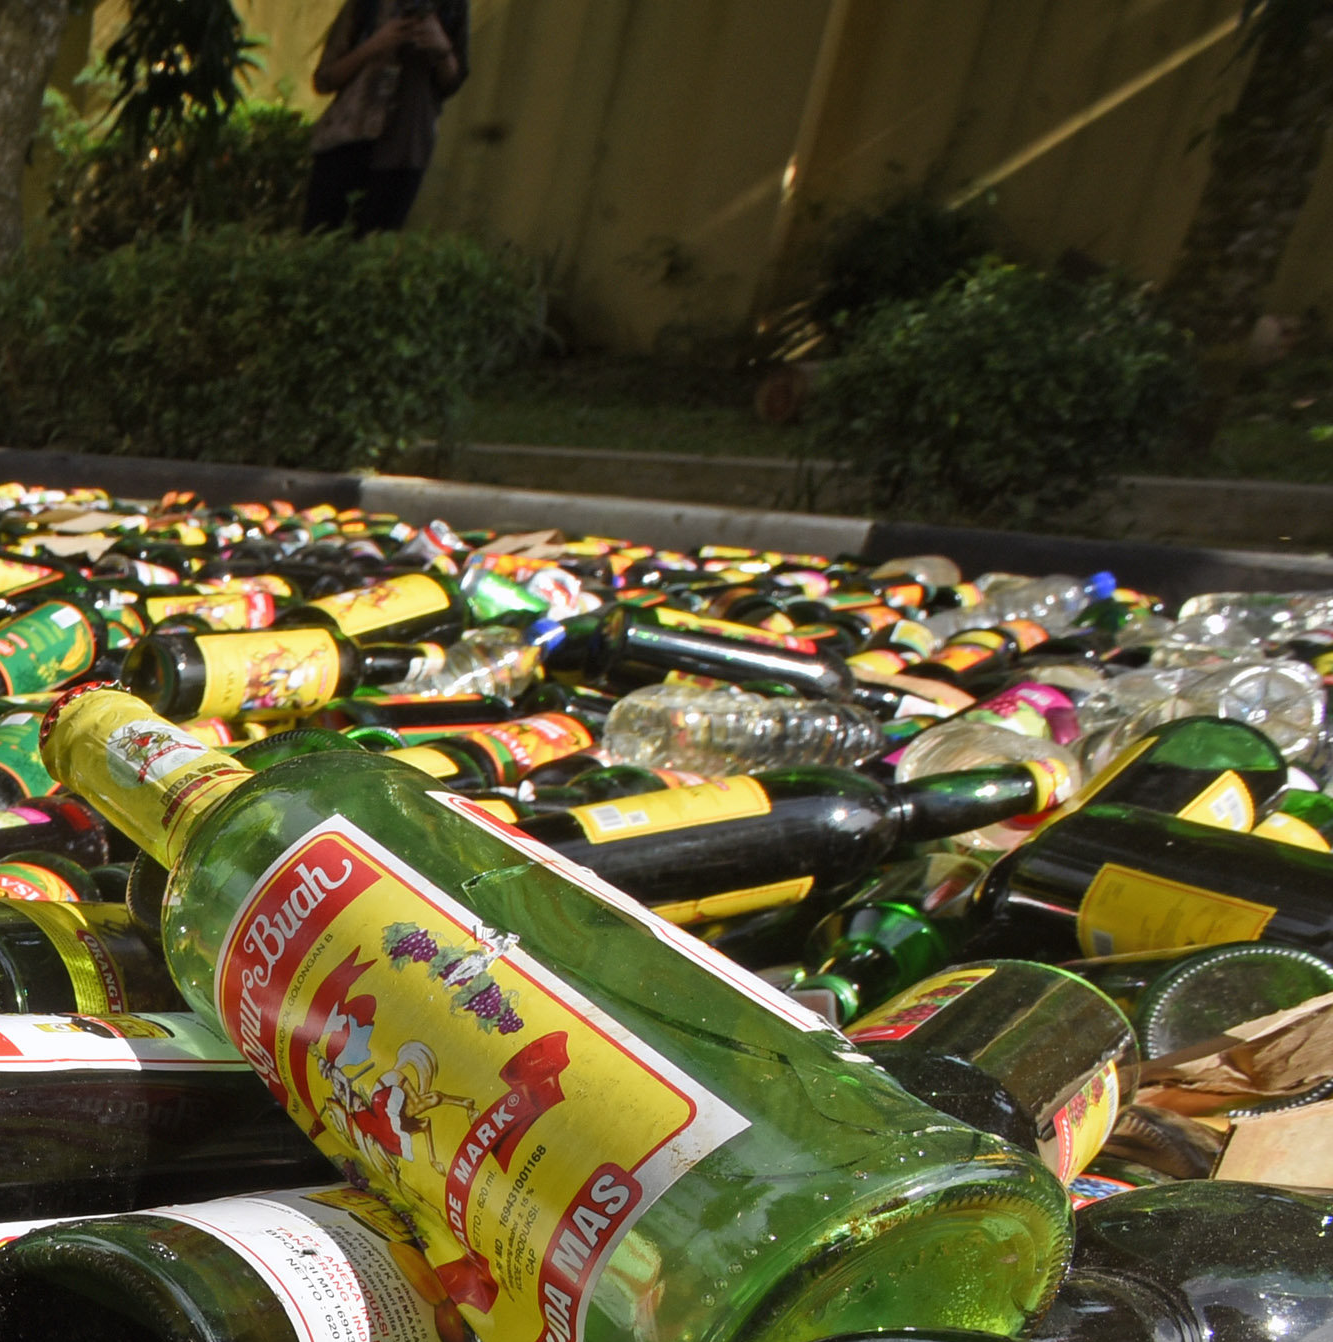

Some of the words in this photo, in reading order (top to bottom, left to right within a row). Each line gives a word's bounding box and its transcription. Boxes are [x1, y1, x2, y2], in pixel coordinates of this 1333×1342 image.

[243, 858, 353, 988] Buah
[550, 1172, 632, 1286] MAS
[284, 1256, 323, 1303] NETTO
[323, 1313, 343, 1338] 620
[322, 1253, 364, 1304] ANEKA
[343, 1259, 390, 1338] PRODUKSI
